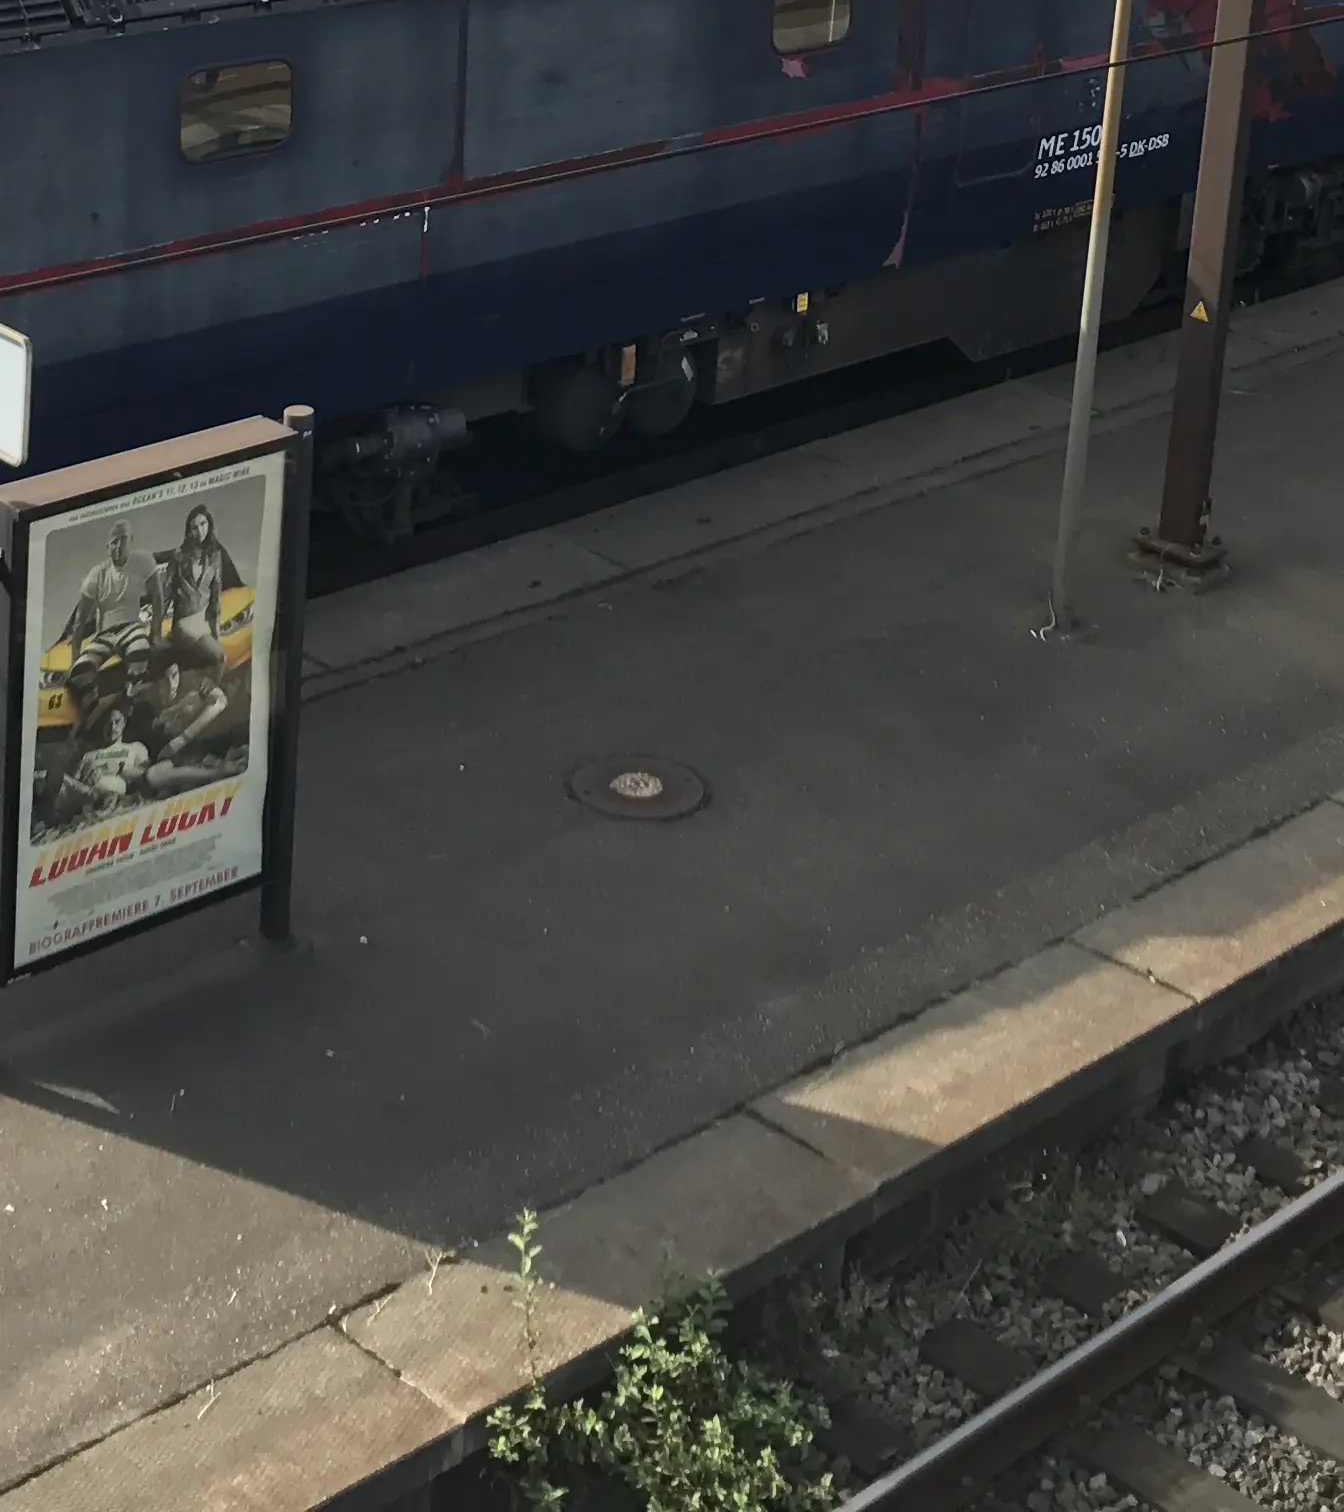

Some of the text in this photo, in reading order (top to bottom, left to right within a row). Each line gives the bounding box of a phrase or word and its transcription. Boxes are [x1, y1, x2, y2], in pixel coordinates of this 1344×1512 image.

[1034, 164, 1048, 179] 92
[1050, 158, 1065, 175] 86
[1067, 151, 1093, 171] 0001
[1129, 133, 1169, 158] DK-DSB
[1038, 124, 1103, 160] ME 150
[28, 815, 139, 889] LOGAN
[139, 779, 245, 846] LUCKY
[169, 865, 239, 904] SEPTEMBER
